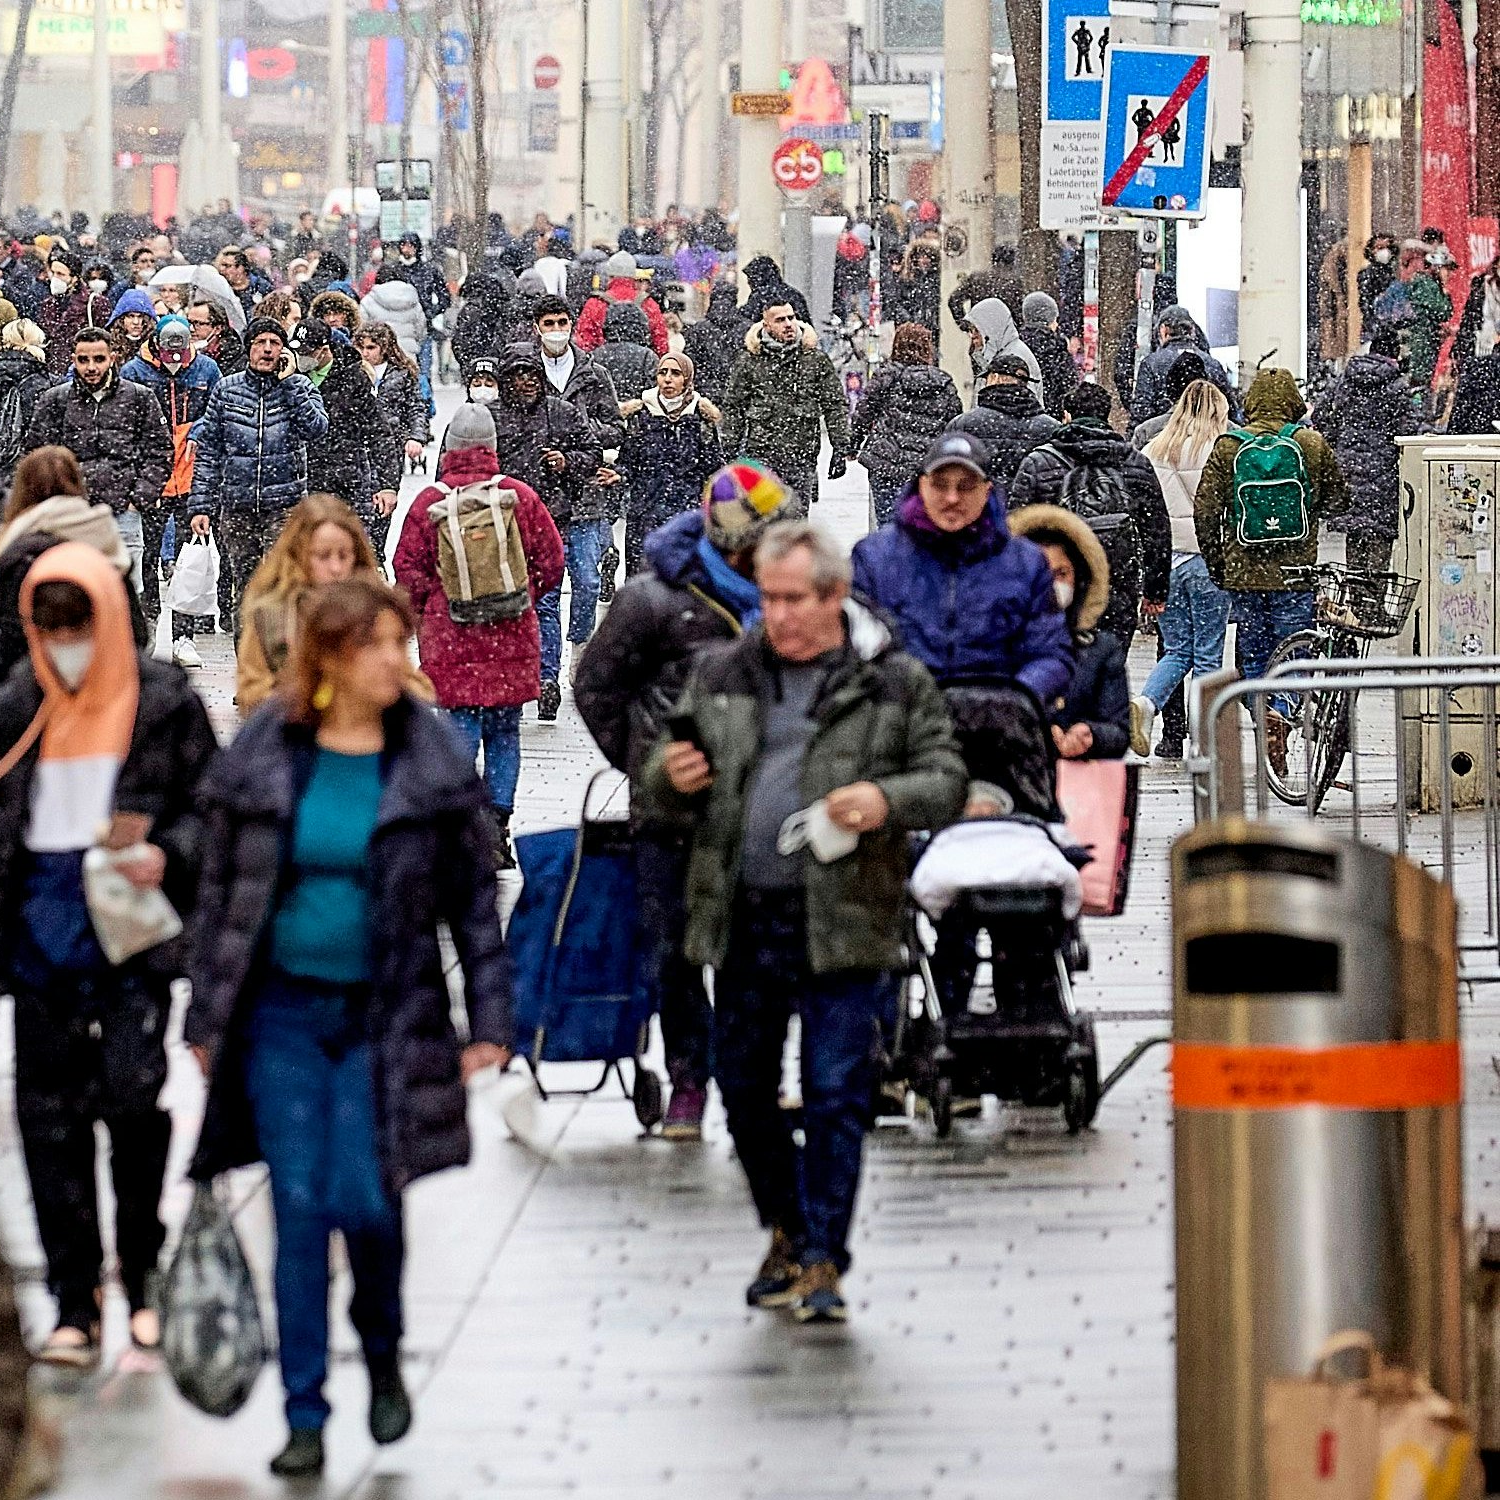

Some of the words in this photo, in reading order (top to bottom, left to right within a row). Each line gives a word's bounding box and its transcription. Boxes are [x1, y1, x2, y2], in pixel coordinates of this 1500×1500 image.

[37, 17, 128, 33] MERKR
[1062, 156, 1075, 164] die
[1048, 192, 1065, 200] zum
